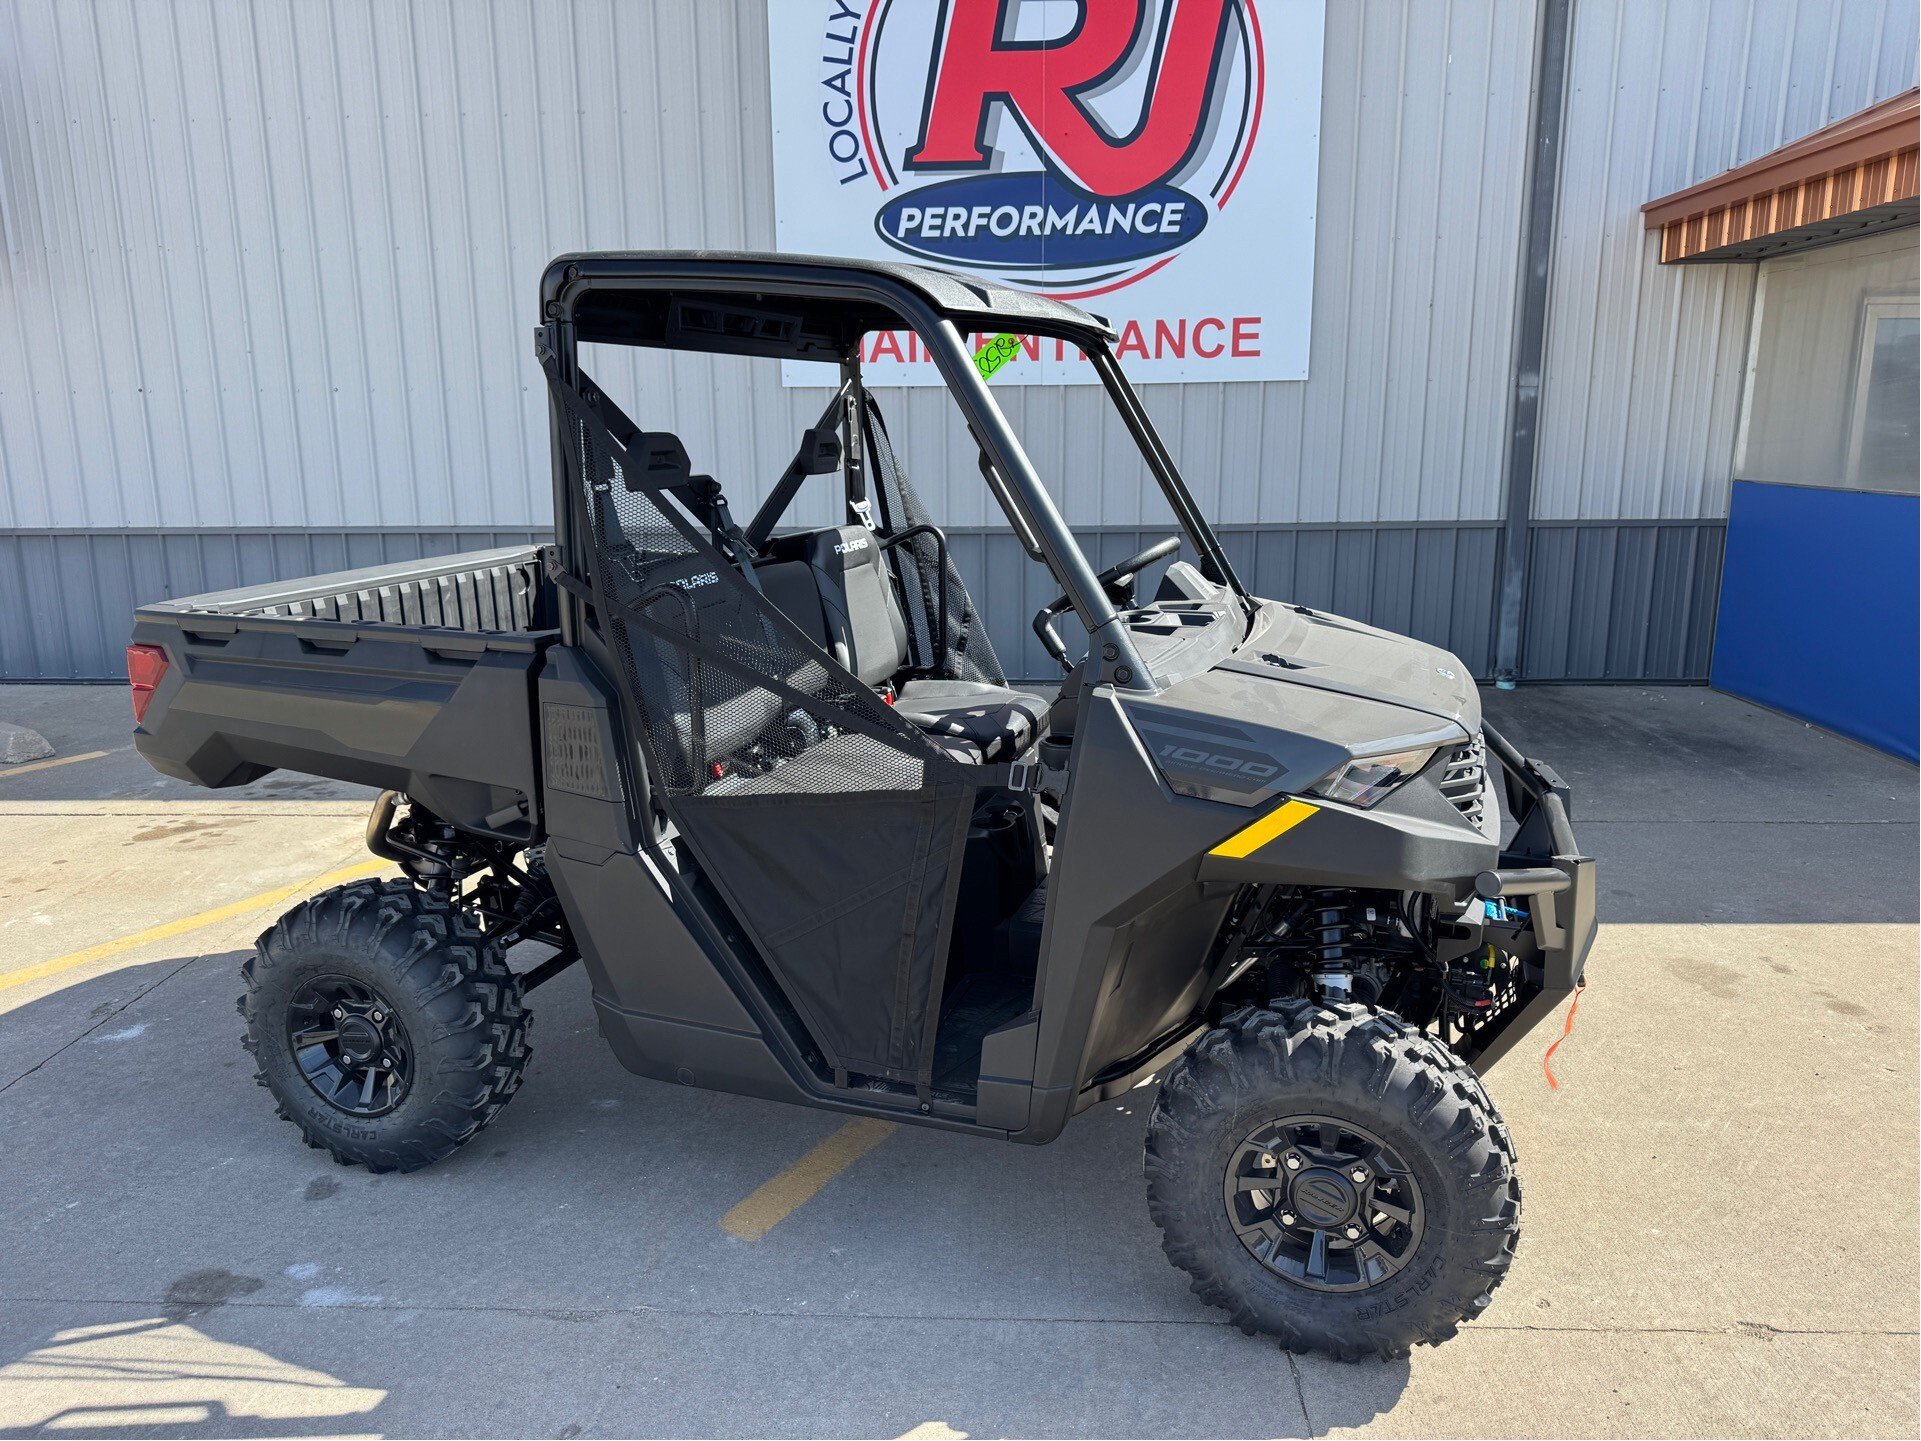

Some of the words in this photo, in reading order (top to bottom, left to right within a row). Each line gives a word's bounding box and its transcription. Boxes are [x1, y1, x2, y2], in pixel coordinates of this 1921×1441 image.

[822, 0, 868, 185] LOCALLY
[902, 0, 1236, 198] RJ
[896, 202, 1186, 238] PERFORMANCE
[858, 330, 932, 363] AI
[834, 537, 870, 556] POLARIS
[669, 571, 720, 591] OLARIS
[1158, 744, 1279, 778] 1000
[307, 1106, 377, 1140] CARLSTAR
[1355, 1254, 1447, 1322] CARLSTAR
